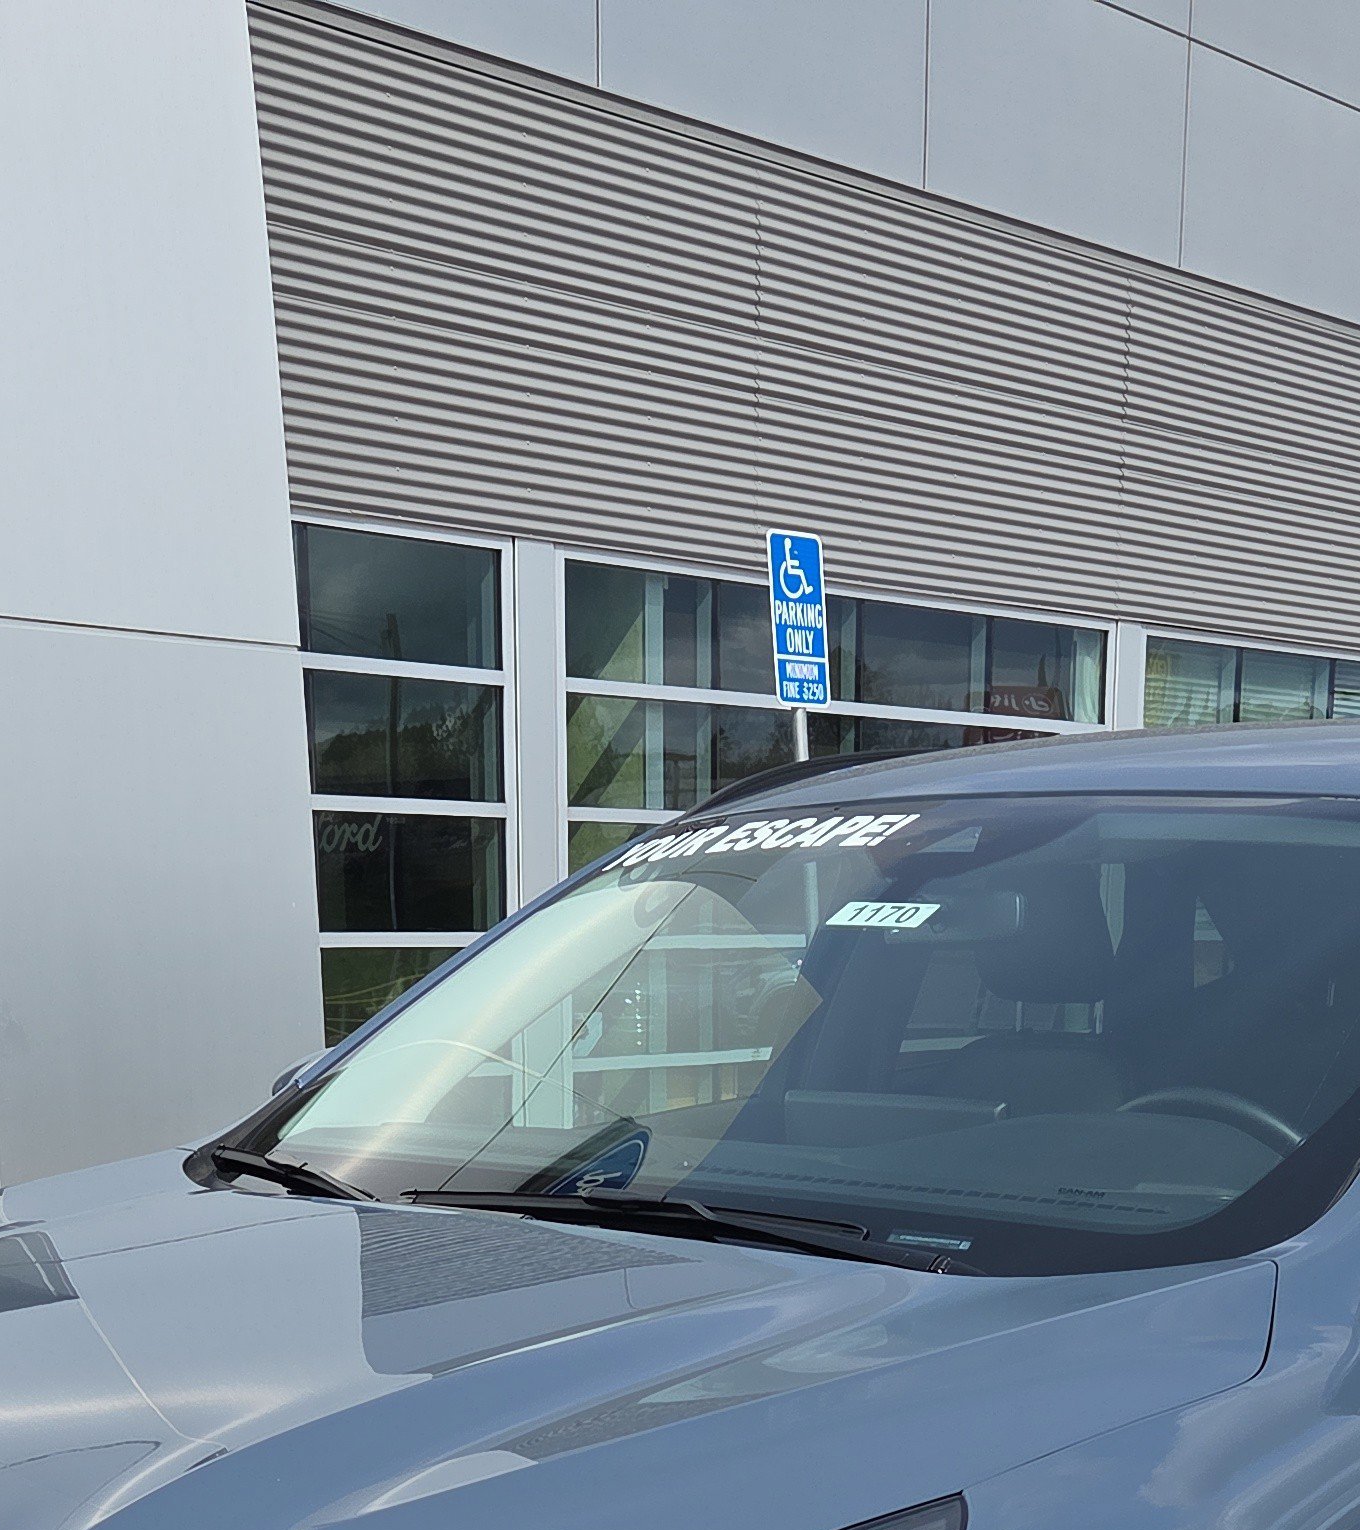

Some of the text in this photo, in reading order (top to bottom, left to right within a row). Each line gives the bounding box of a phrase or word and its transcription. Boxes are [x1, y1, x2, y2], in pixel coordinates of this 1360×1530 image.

[775, 599, 823, 630] PARKING
[786, 628, 815, 654] ONLY
[802, 682, 824, 702] $250
[319, 814, 383, 853] ord
[601, 813, 920, 872] YOUR ESCAPE!
[847, 903, 922, 925] 1170
